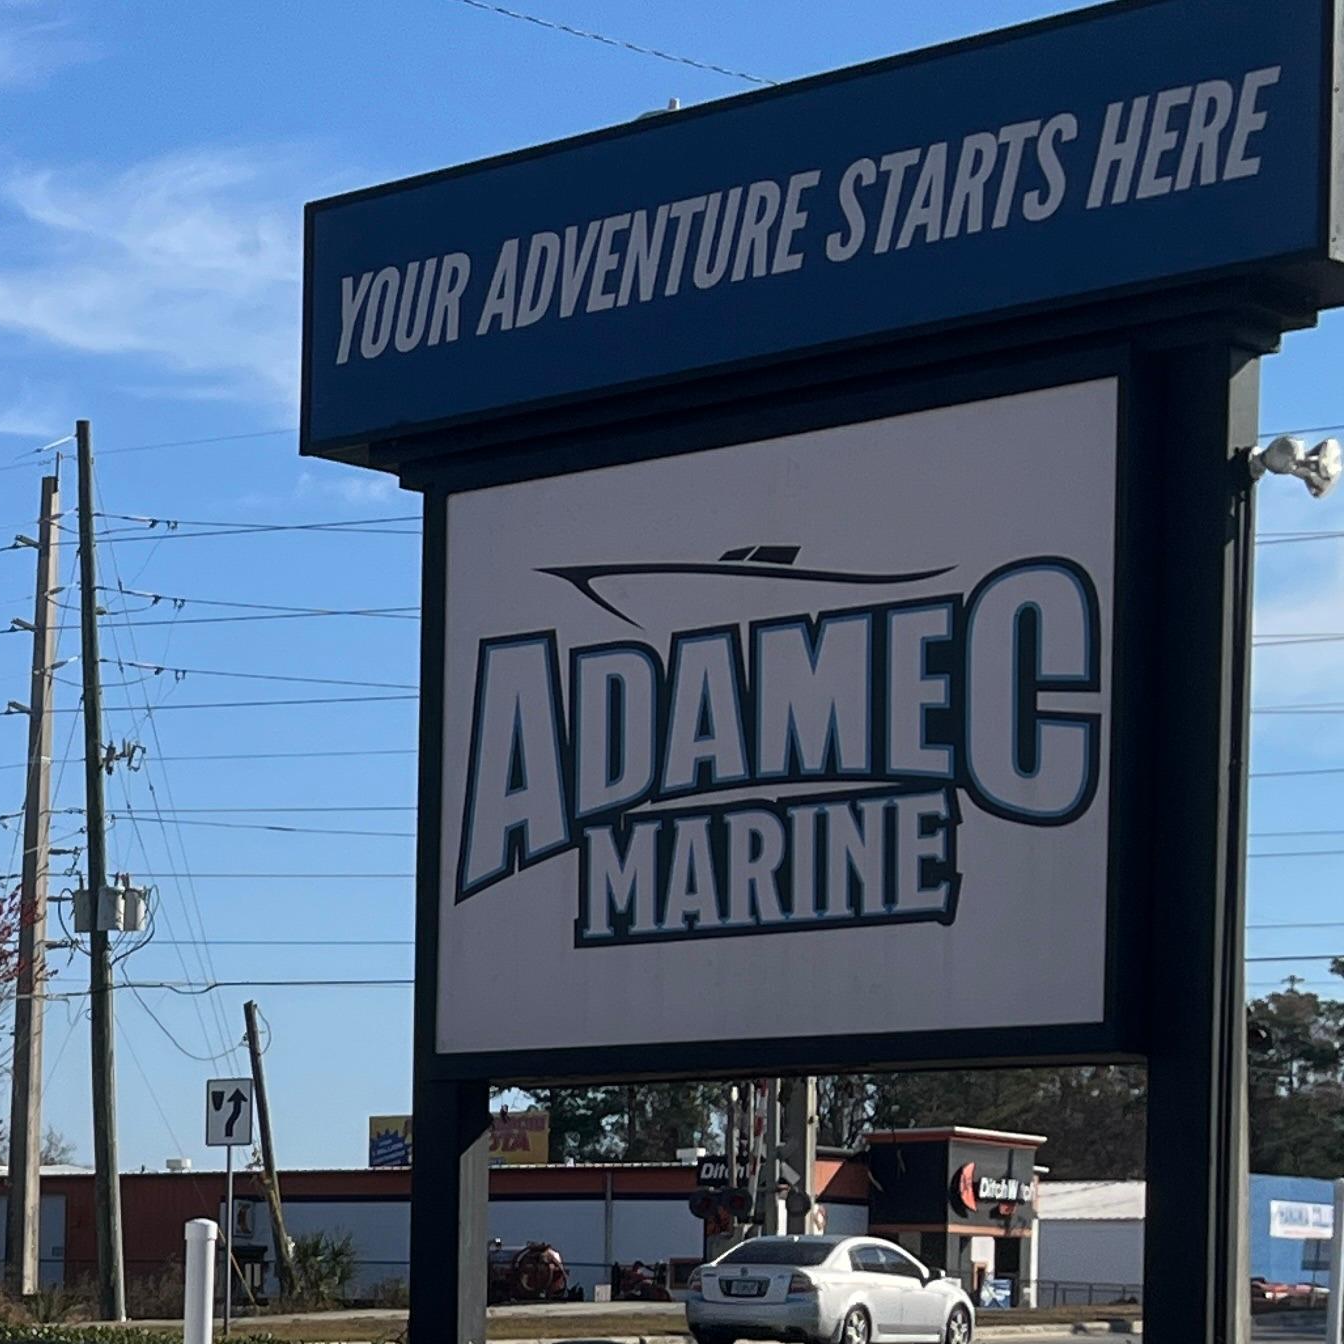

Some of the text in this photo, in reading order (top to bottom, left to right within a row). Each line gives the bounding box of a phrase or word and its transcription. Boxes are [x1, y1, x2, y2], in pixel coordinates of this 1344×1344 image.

[336, 66, 1281, 366] YOUR ADVENTURE STARTS HERE
[455, 555, 1103, 905] ADAMEC
[575, 786, 963, 949] MARINE
